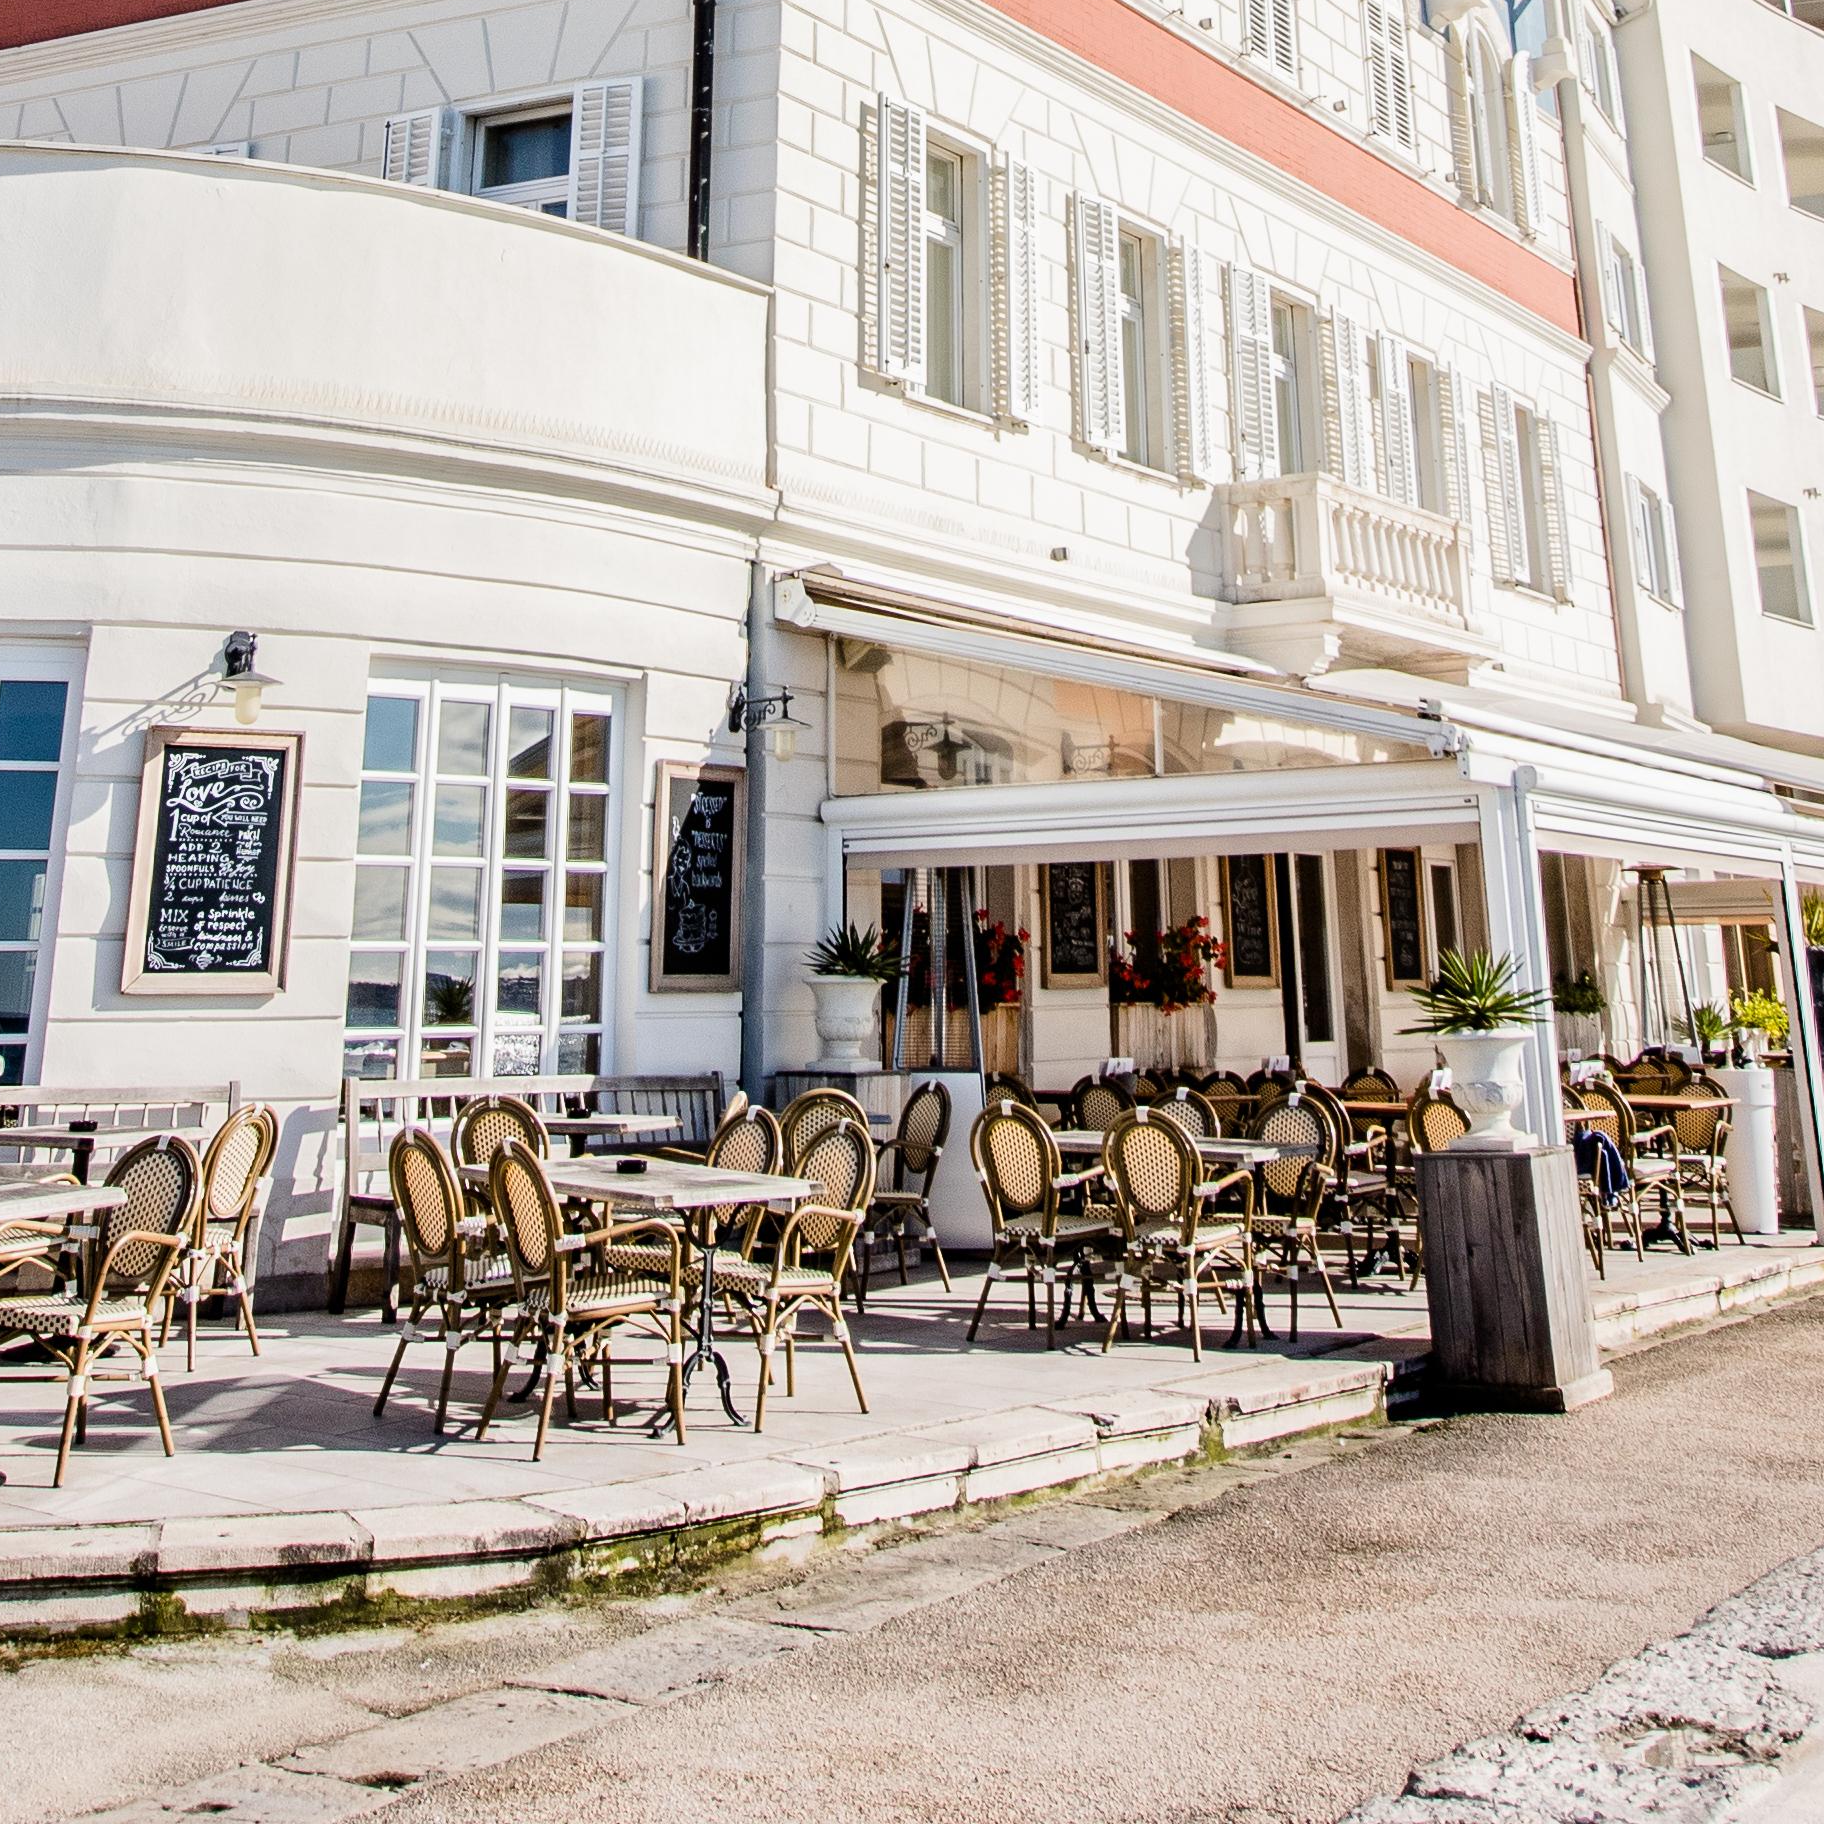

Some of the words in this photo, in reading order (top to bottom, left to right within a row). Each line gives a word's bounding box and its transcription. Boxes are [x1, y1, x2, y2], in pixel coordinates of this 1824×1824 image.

[230, 764, 247, 773] FOR
[166, 779, 231, 805] Love
[168, 807, 180, 842] 1
[180, 813, 200, 825] cup
[200, 811, 214, 826] of
[234, 814, 250, 823] WILL
[178, 822, 234, 839] Romance
[179, 842, 204, 852] ADD
[208, 841, 223, 854] 2
[167, 853, 230, 863] HEAPING
[165, 864, 215, 873] SPOONFULS
[178, 877, 203, 890] CUP
[203, 878, 254, 891] PATIENCE
[163, 891, 175, 902] 2
[159, 907, 189, 923] MIX
[196, 910, 205, 919] a
[207, 920, 248, 932] respect
[244, 930, 254, 942] &
[162, 939, 187, 948] SMILE
